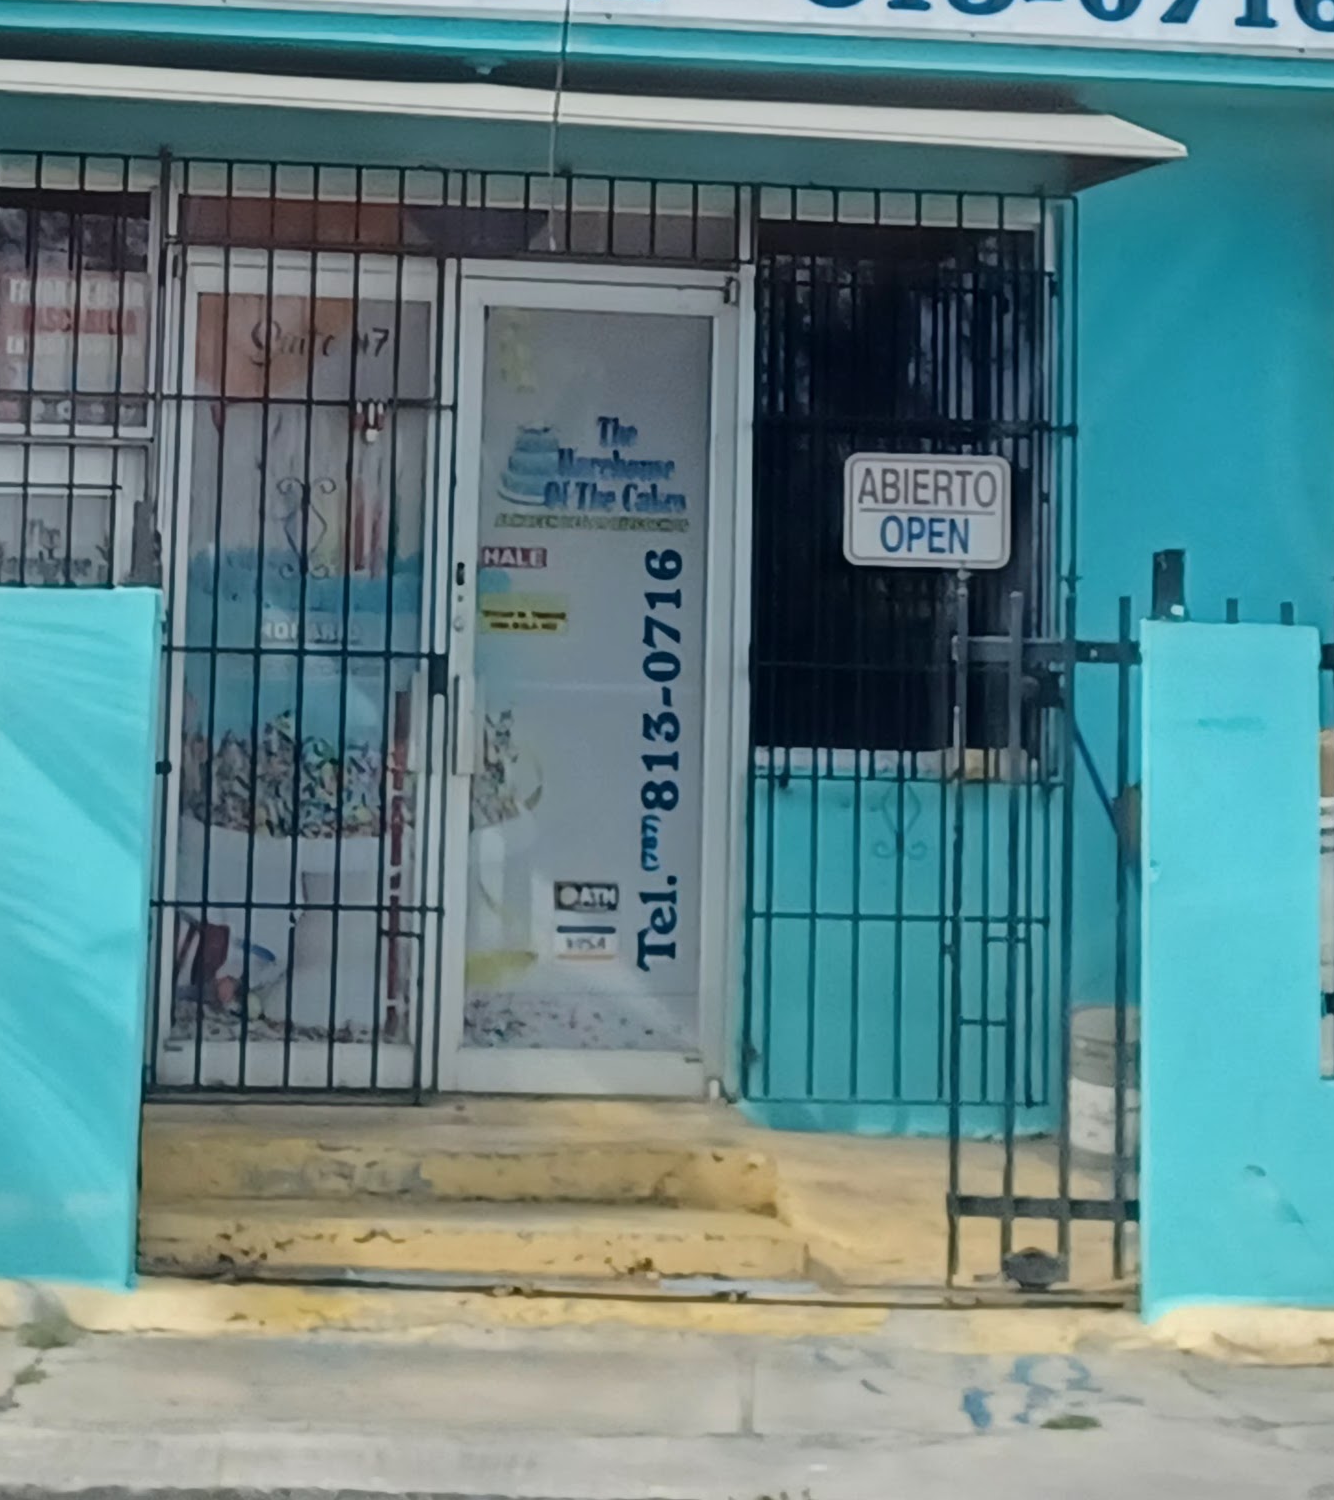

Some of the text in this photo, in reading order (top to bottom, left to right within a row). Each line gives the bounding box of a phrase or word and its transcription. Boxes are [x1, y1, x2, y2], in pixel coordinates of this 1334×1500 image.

[858, 468, 997, 508] ABIERTO
[880, 515, 969, 554] OPEN
[640, 548, 683, 812] 813-0716
[636, 876, 678, 972] Tel.
